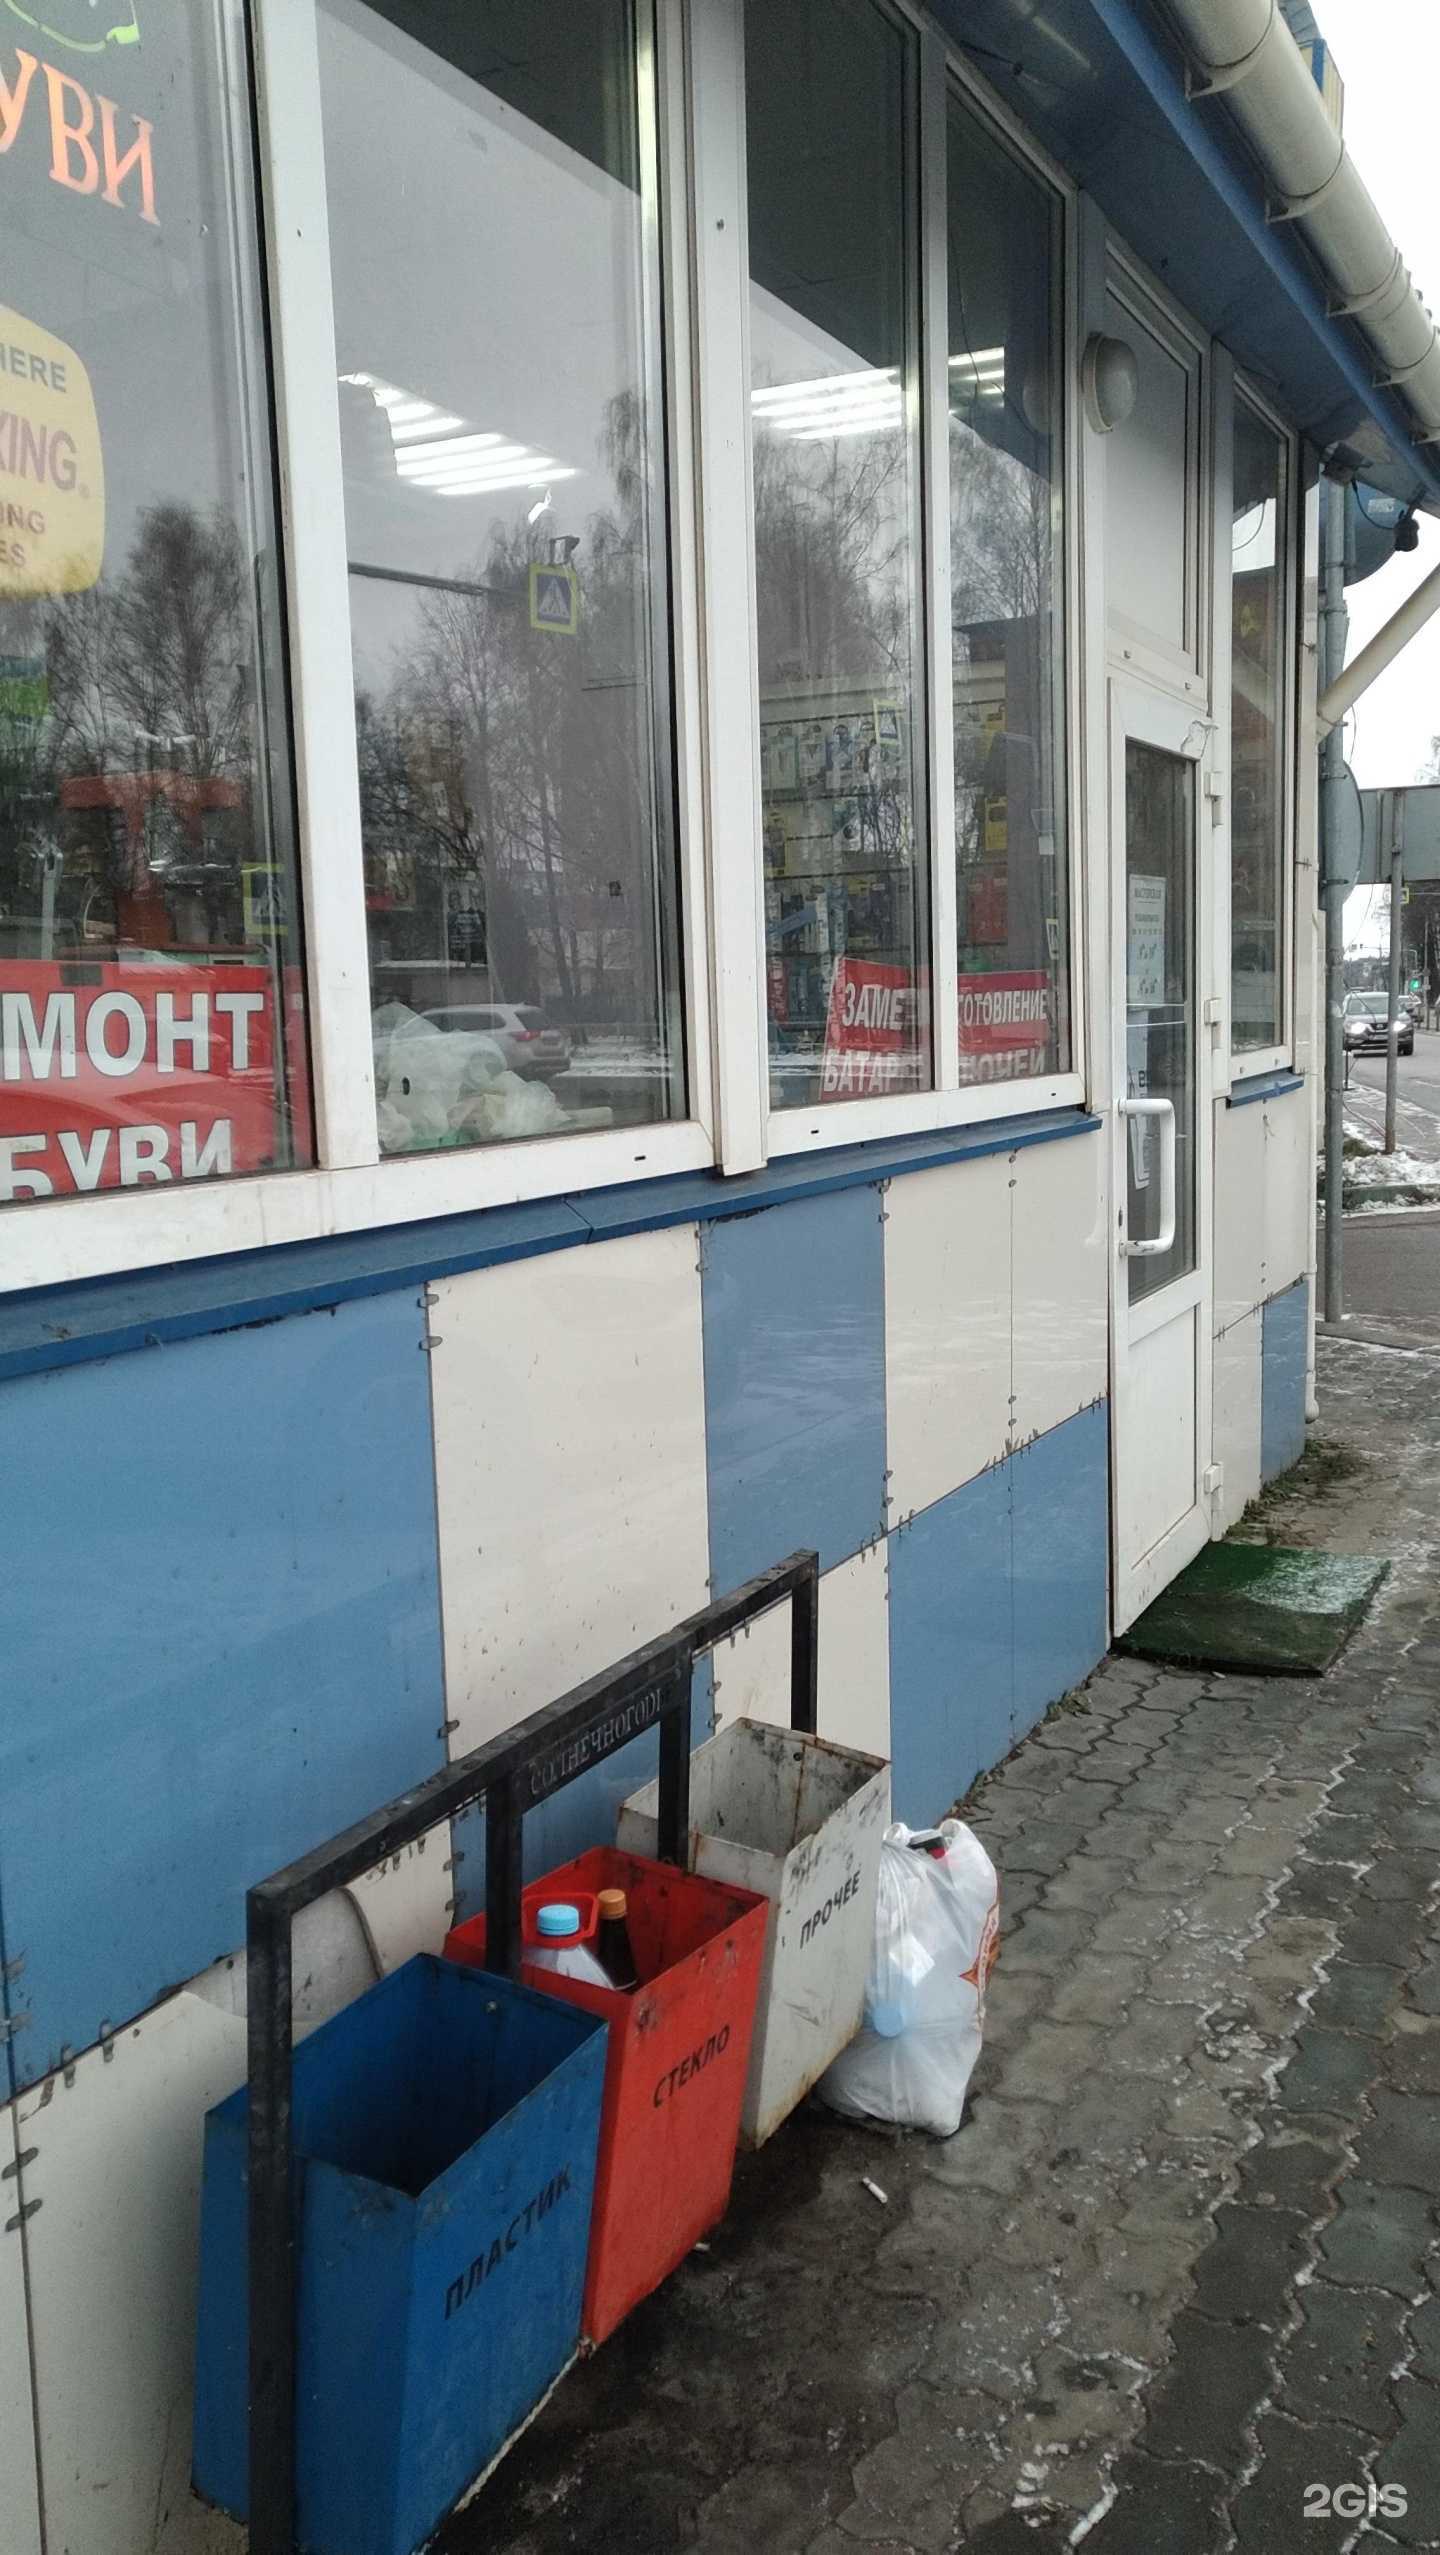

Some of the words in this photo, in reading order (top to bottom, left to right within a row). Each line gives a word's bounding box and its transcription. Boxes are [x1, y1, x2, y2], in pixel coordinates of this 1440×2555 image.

[0, 991, 265, 1081] МОНТ
[800, 1869, 861, 1949] ПРОЧЕЕ
[653, 2024, 730, 2108] СТЕКЛО
[444, 2161, 571, 2321] ПЛАСТИК
